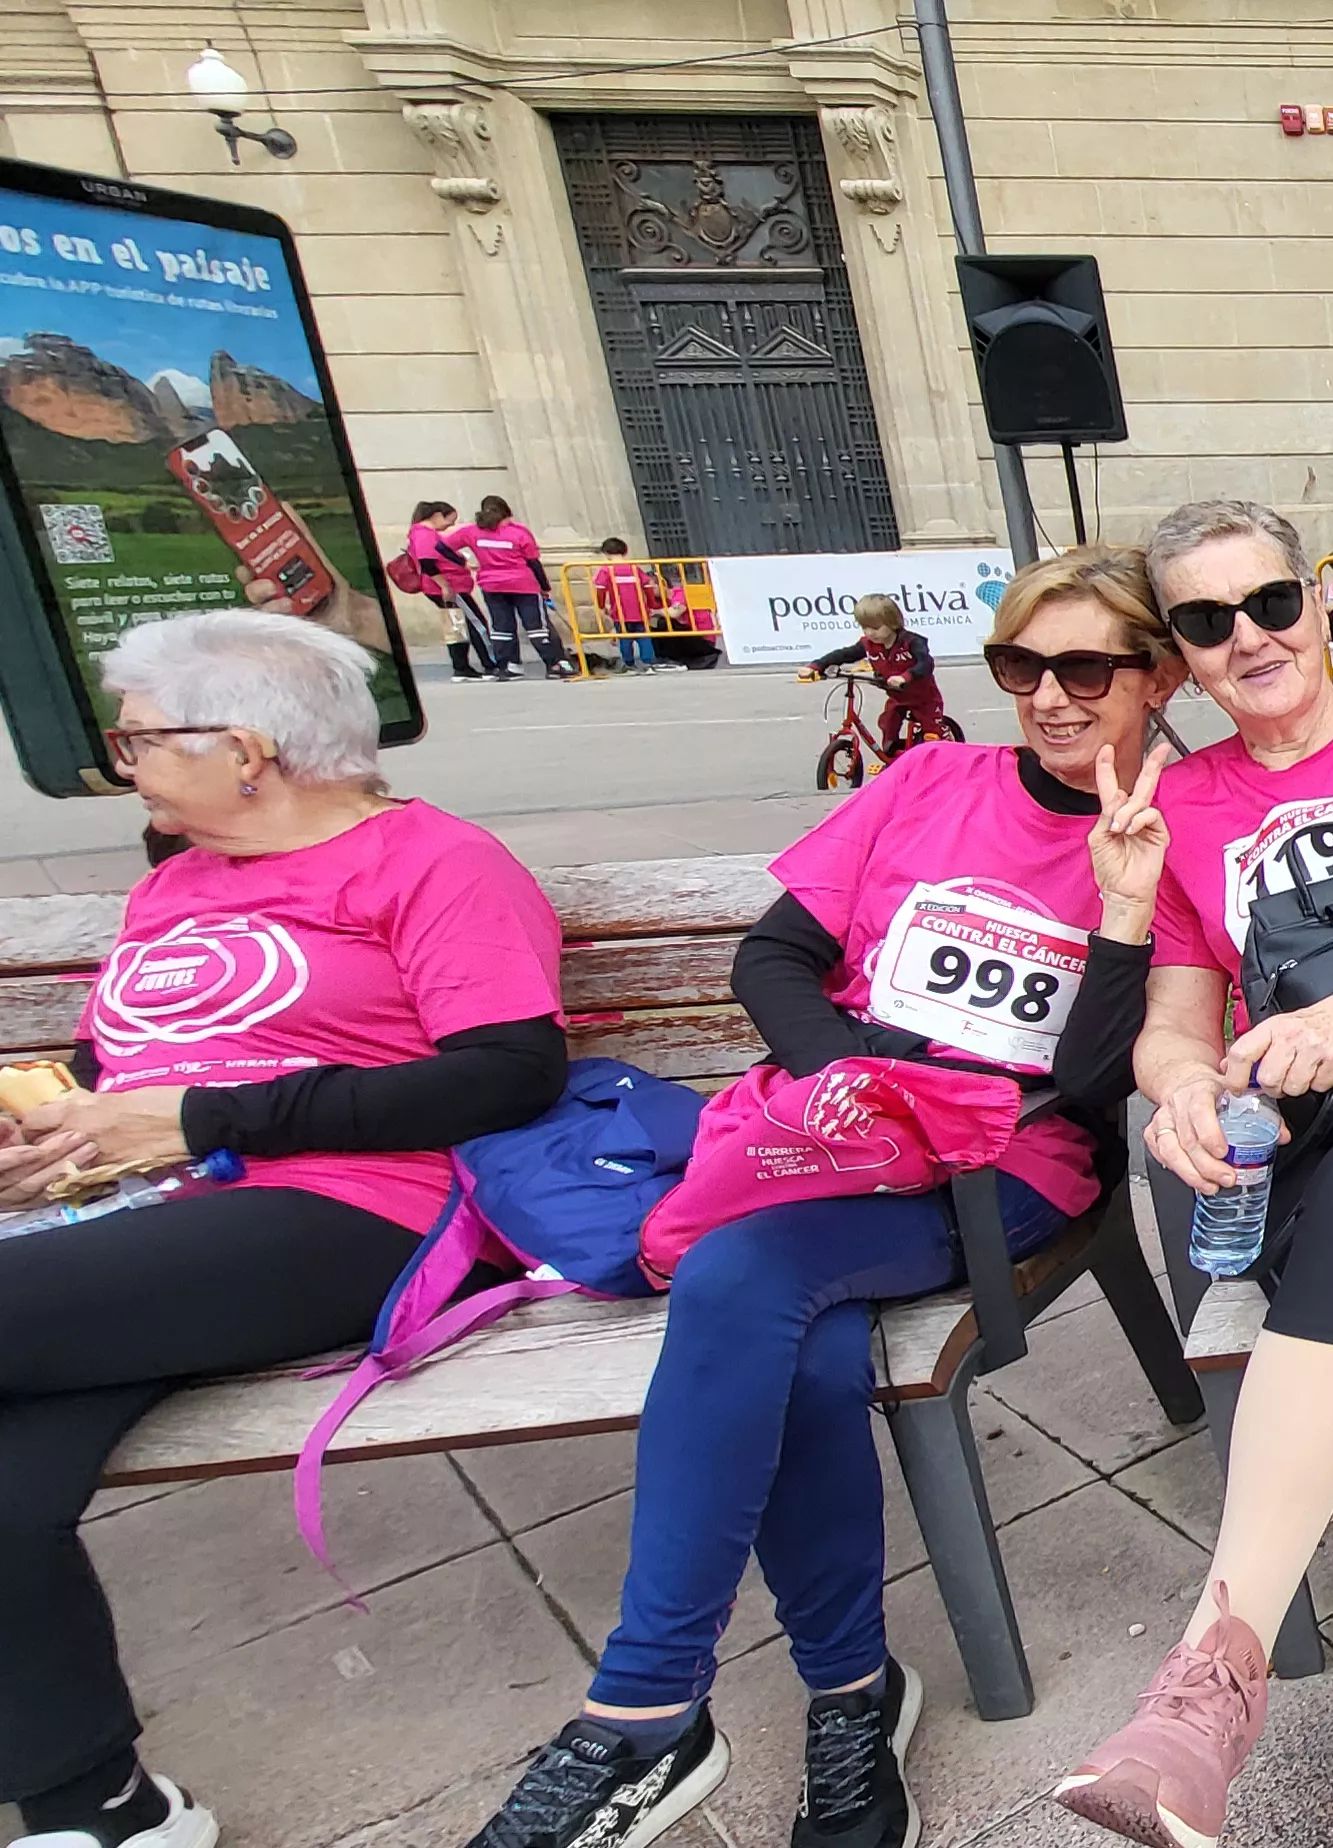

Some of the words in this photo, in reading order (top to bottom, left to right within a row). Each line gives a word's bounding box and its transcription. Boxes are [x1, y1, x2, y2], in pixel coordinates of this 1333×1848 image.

[52, 233, 104, 265] en
[110, 237, 150, 272] el
[155, 249, 271, 292] paisaje
[66, 279, 101, 295] APP
[769, 583, 969, 632] podotiva
[1247, 824, 1293, 866] CONTRA
[1294, 813, 1312, 826] EL
[921, 915, 995, 947] CONTRA
[997, 936, 1019, 955] EL
[1022, 945, 1087, 974] CÁNCER
[985, 920, 1039, 945] HUESCA
[925, 945, 1060, 1023] 998
[758, 1146, 814, 1157] CARRERA
[762, 1155, 804, 1167] HUESCA
[756, 1171, 772, 1180] EL
